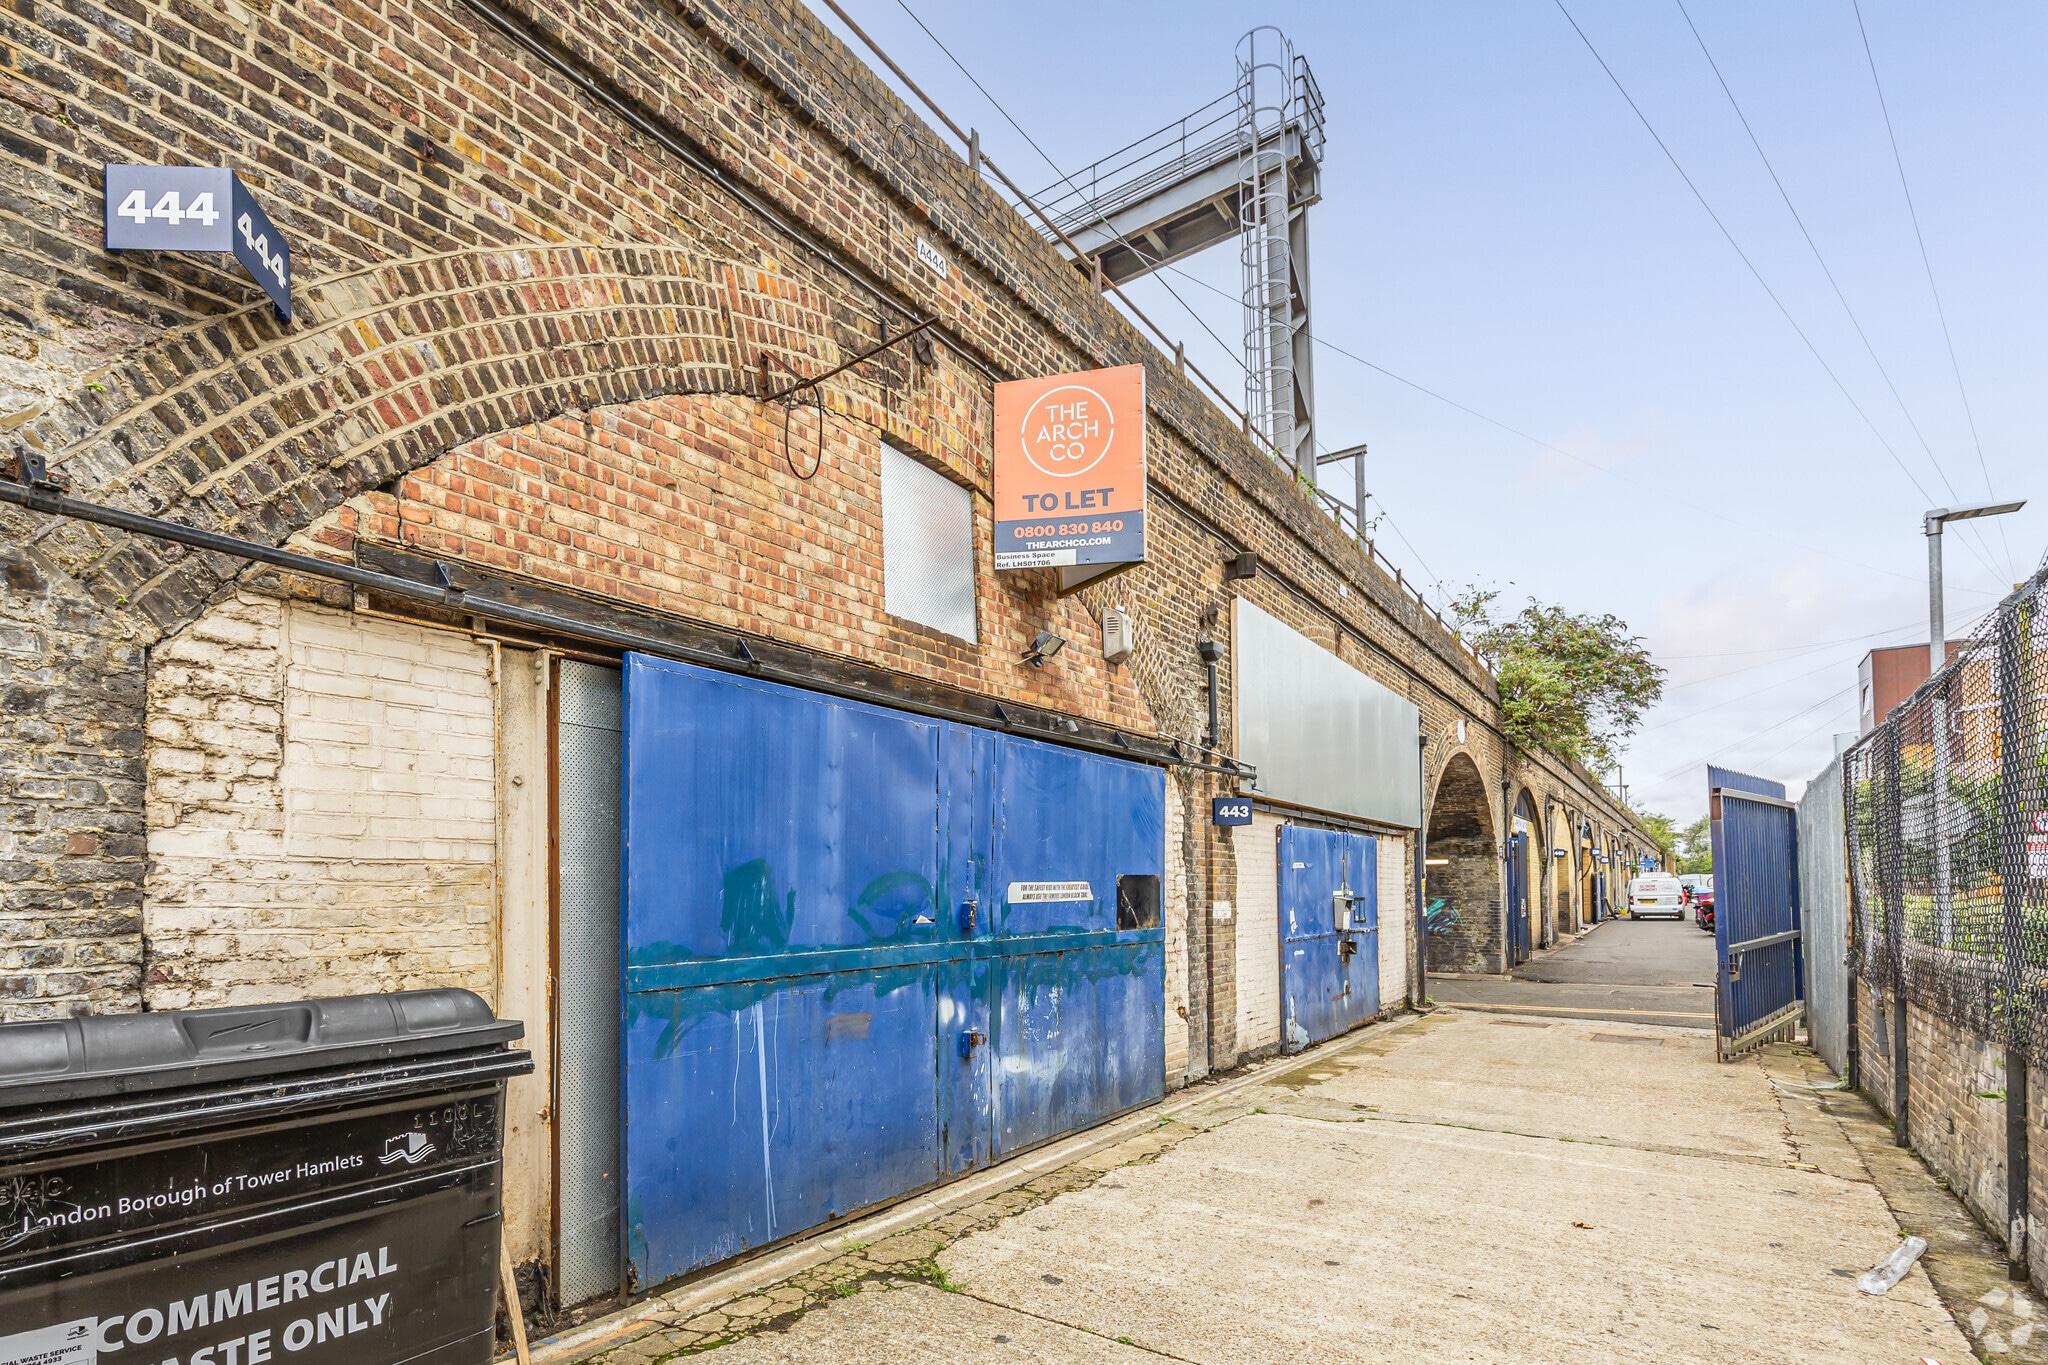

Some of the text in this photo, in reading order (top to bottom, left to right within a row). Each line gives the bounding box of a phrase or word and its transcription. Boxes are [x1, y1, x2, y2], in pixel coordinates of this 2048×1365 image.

[117, 190, 220, 226] 444
[237, 212, 287, 289] 444
[920, 243, 945, 273] A444
[1045, 401, 1088, 422] THE
[1036, 420, 1099, 443] ARCH
[1049, 442, 1085, 461] CO
[1022, 488, 1114, 512] TO LET
[1014, 519, 1124, 539] 0800 830 840
[1026, 537, 1111, 550] THEARCHCO.COM
[1032, 552, 1055, 560] Space
[1219, 805, 1249, 818] 443
[22, 1154, 364, 1233] London Borough of Tower Hamlets
[96, 1246, 397, 1352] COMMERCIAL
[282, 1292, 390, 1351] ONLY
[20, 1353, 48, 1364] WASTE
[50, 1344, 82, 1356] SERVICE
[43, 1356, 62, 1365] 4933
